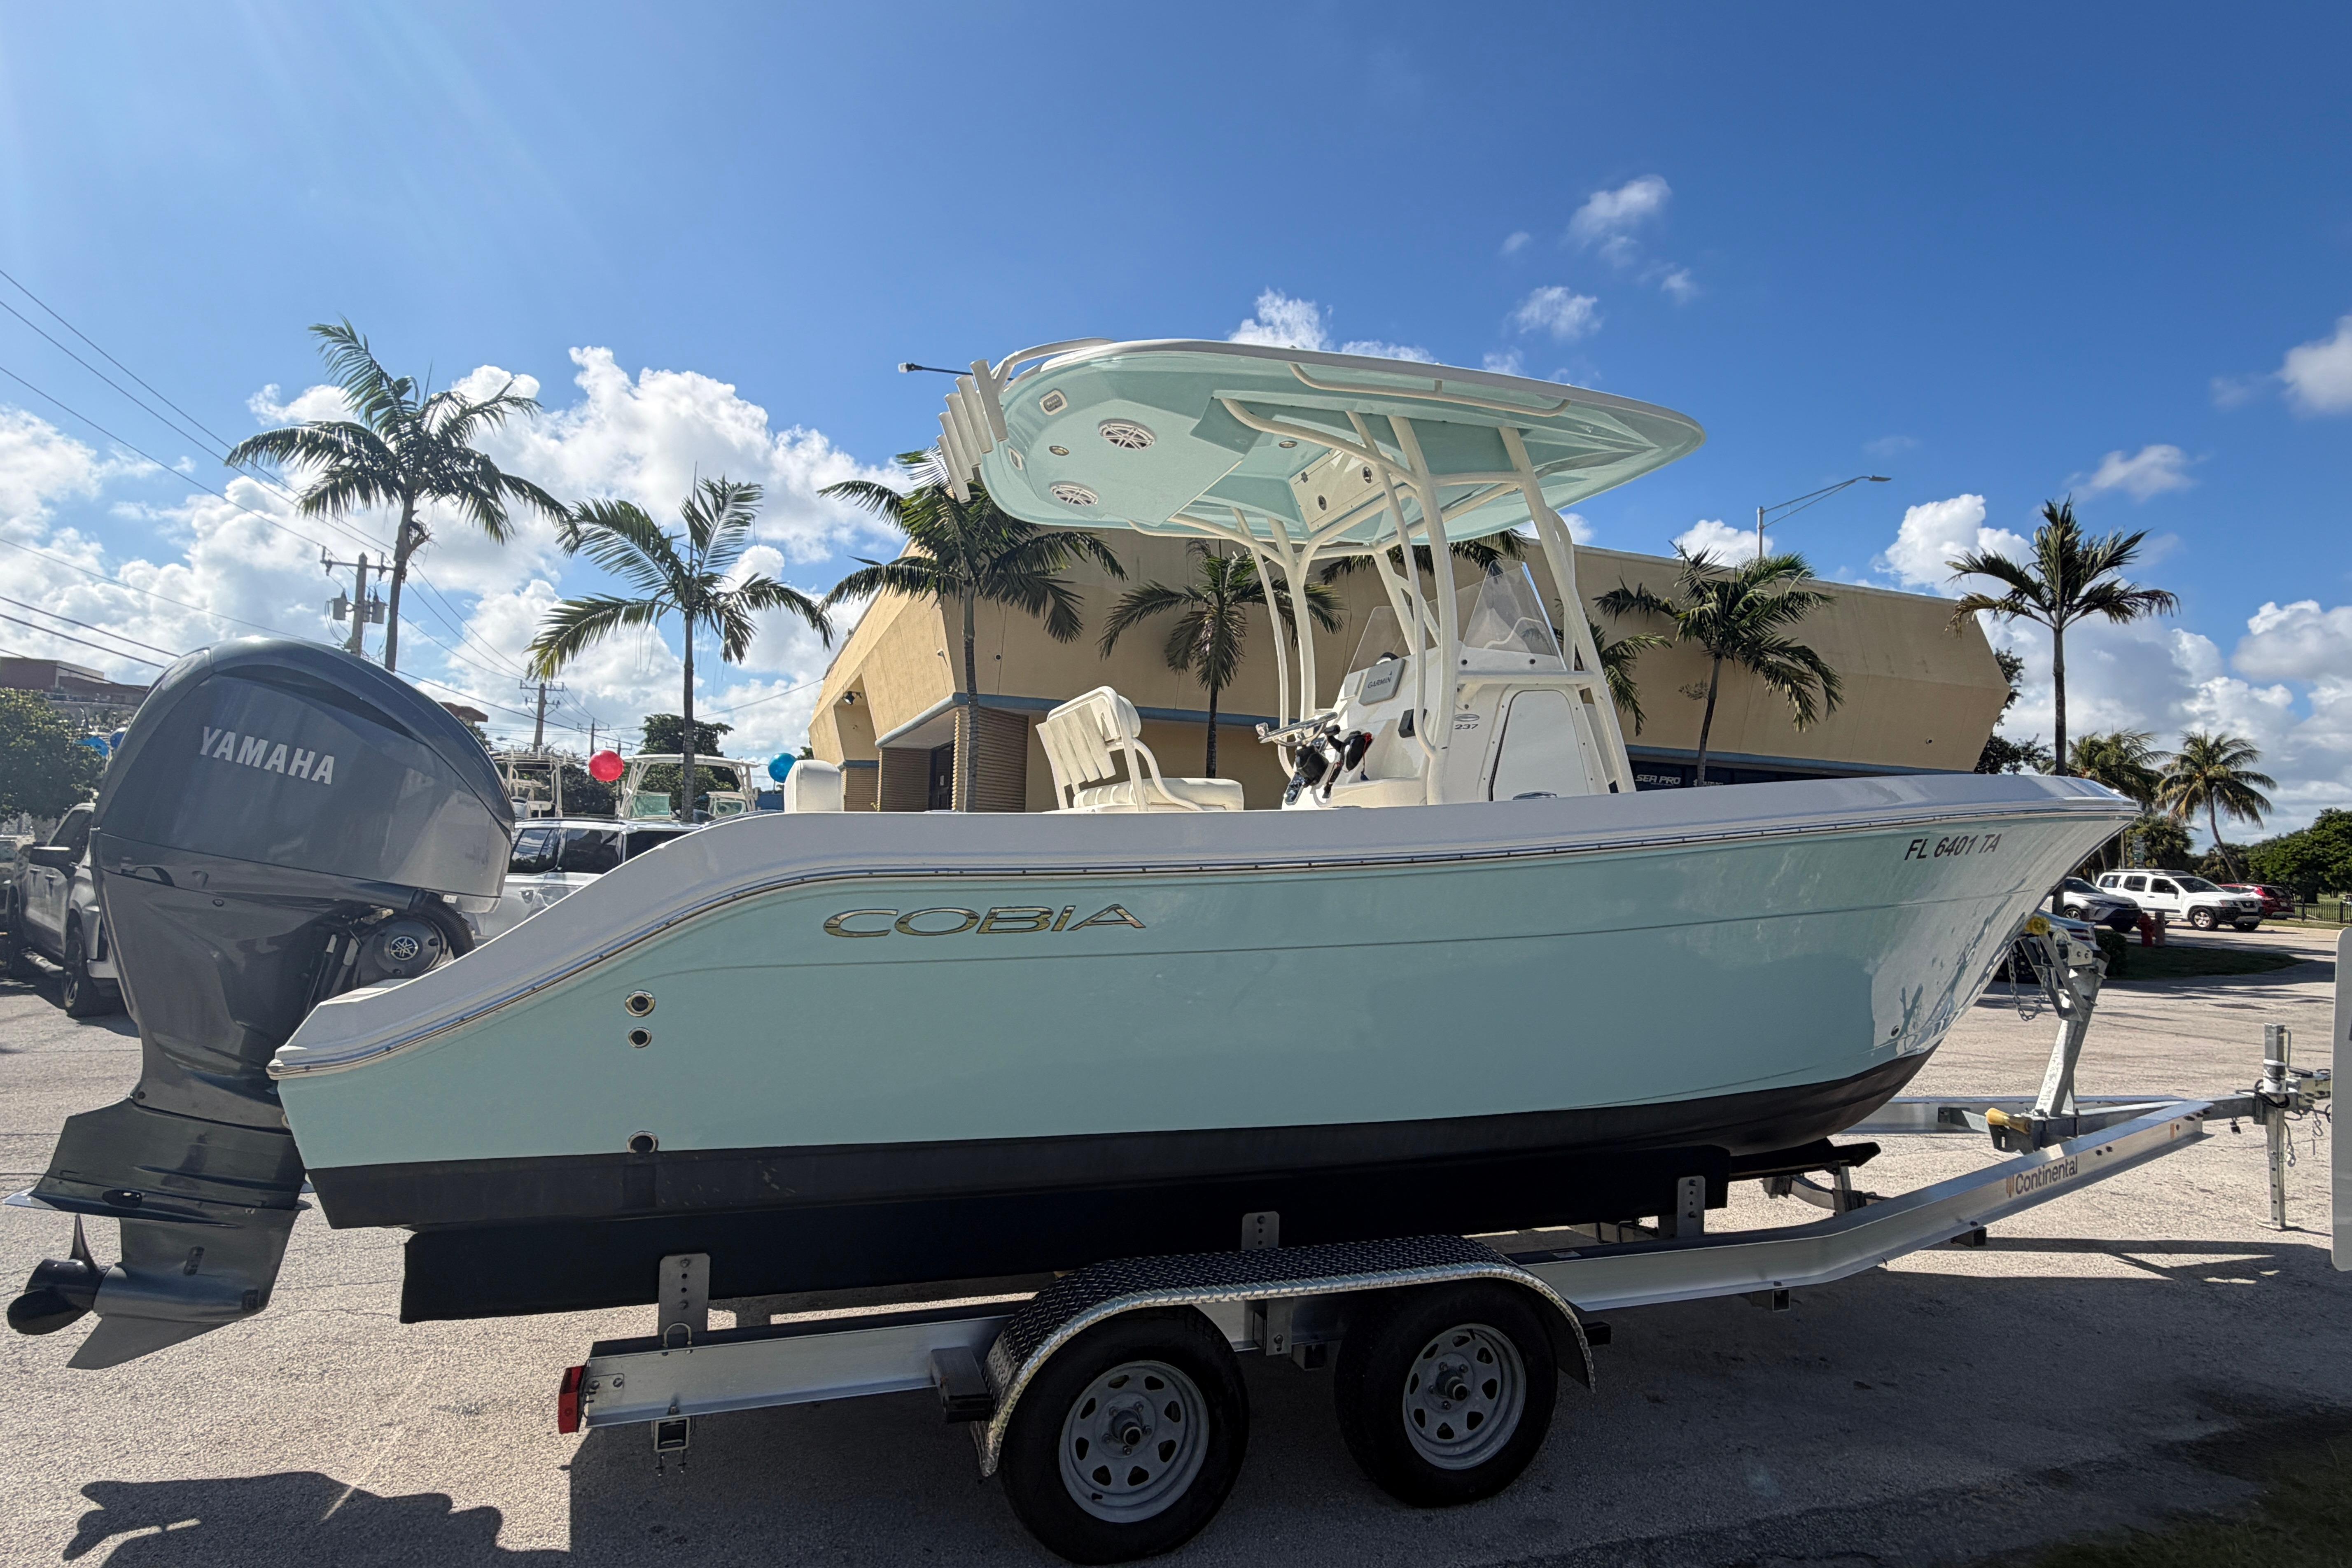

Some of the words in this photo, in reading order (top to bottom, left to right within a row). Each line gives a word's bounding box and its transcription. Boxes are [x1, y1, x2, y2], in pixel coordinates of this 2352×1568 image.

[200, 726, 336, 785] YAMAHA
[1635, 774, 1657, 782] SEA
[1659, 776, 1681, 785] PRO
[1904, 839, 1928, 860] FL
[1934, 835, 1978, 858] 6401
[1978, 834, 2002, 853] TA
[823, 904, 1146, 937] COBIA
[2015, 1155, 2078, 1195] Continental
